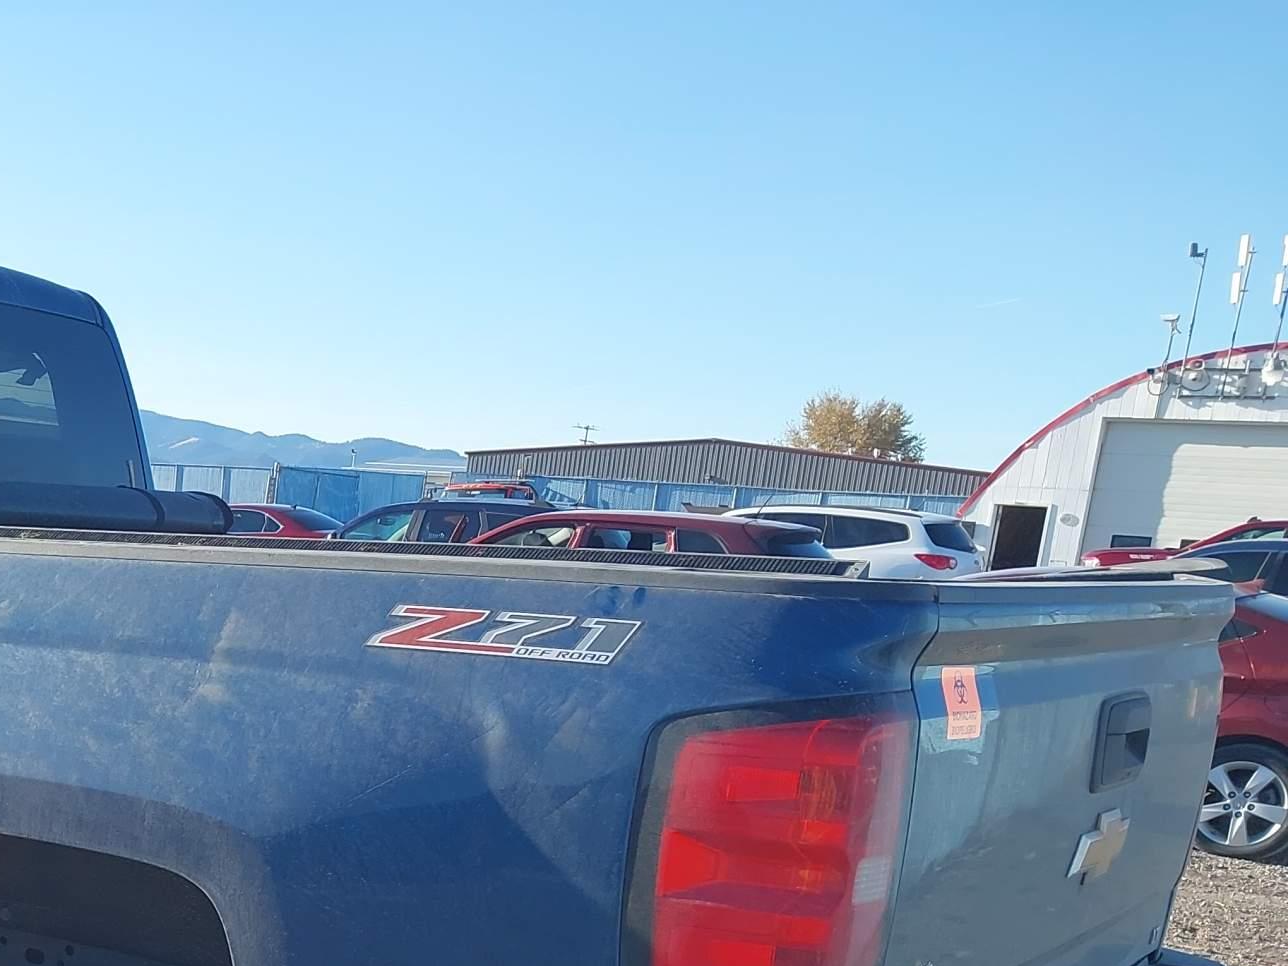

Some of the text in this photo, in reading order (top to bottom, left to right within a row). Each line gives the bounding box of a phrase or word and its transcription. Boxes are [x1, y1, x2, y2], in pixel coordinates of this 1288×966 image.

[367, 604, 641, 657] Z71
[516, 647, 610, 662] OFF ROAD
